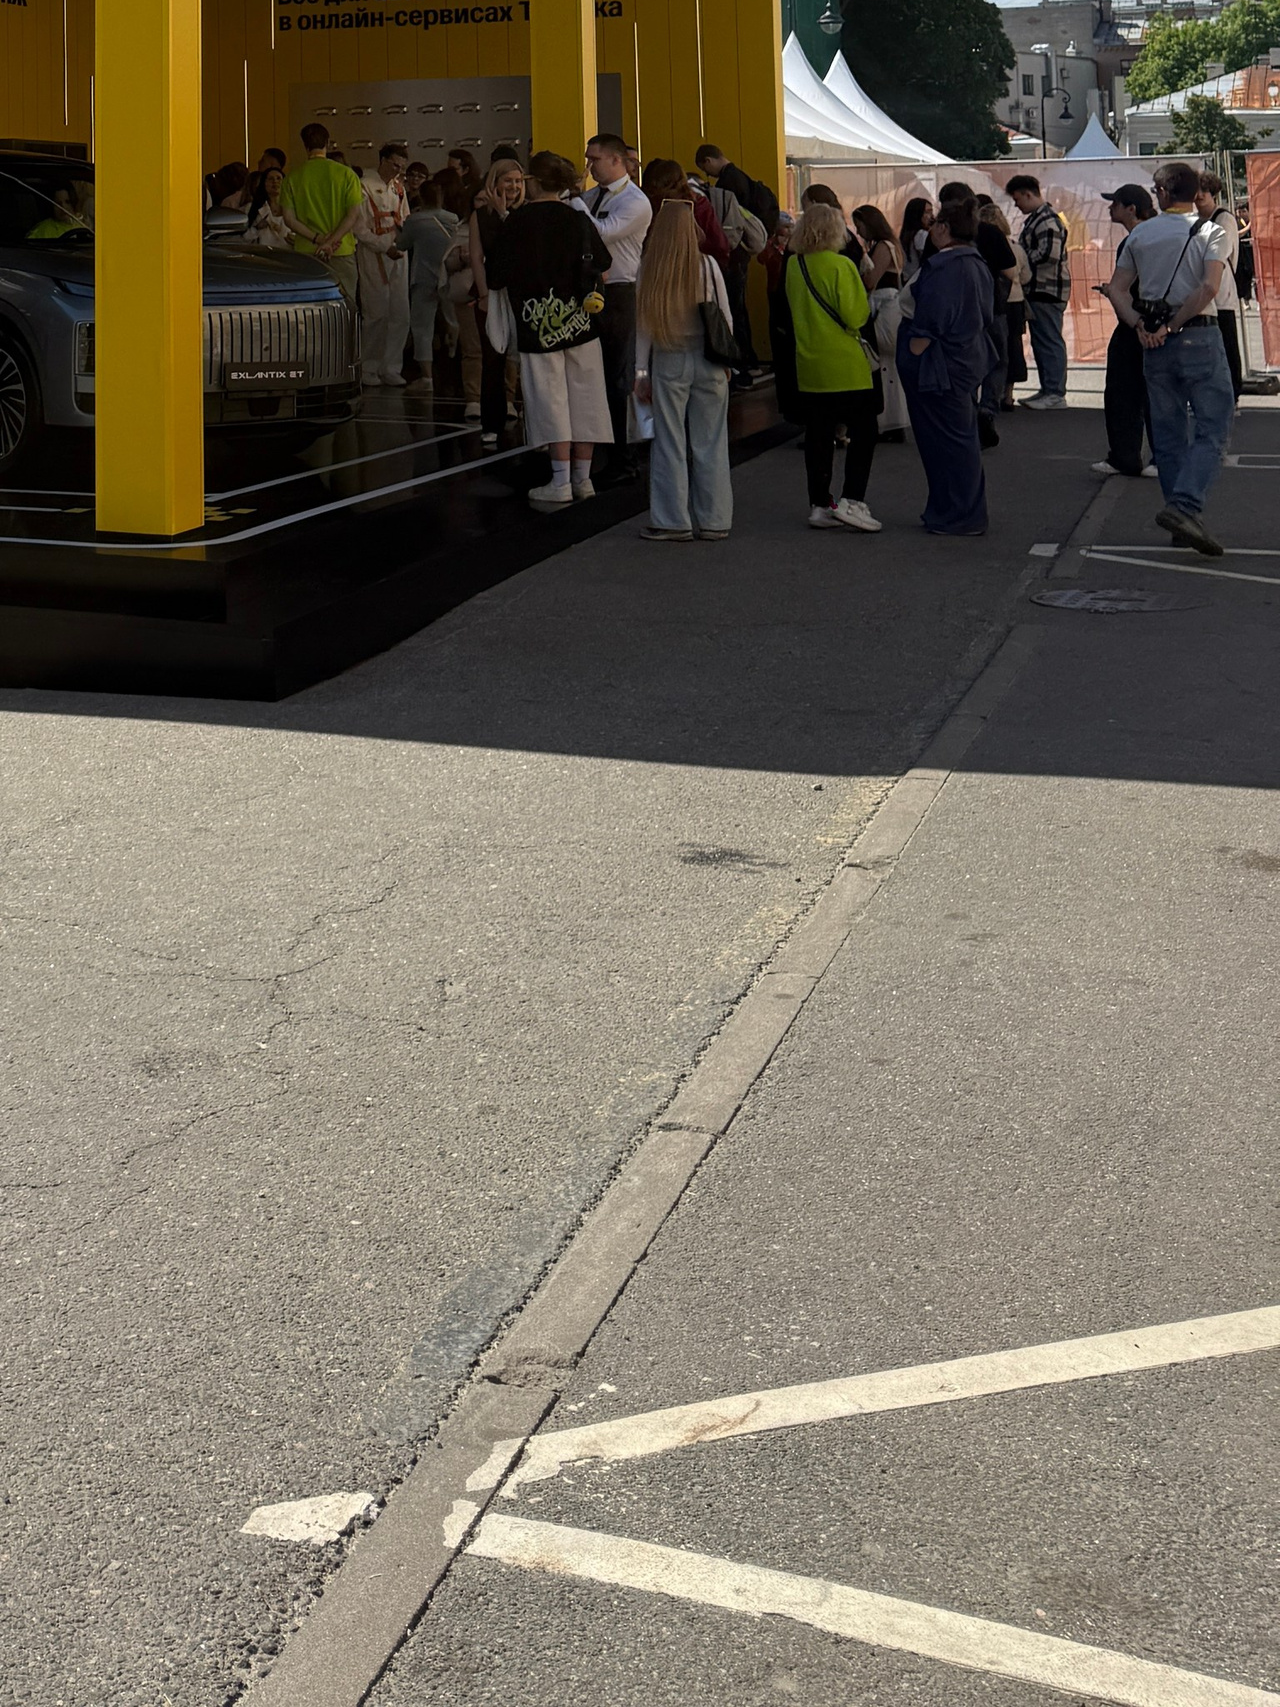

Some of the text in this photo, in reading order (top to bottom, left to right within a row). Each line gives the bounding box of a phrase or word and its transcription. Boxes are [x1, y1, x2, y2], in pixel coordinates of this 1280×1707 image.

[279, 15, 292, 31] в
[297, 5, 513, 31] онлайн-сервисах
[230, 370, 305, 380] EXLANTIX ET
